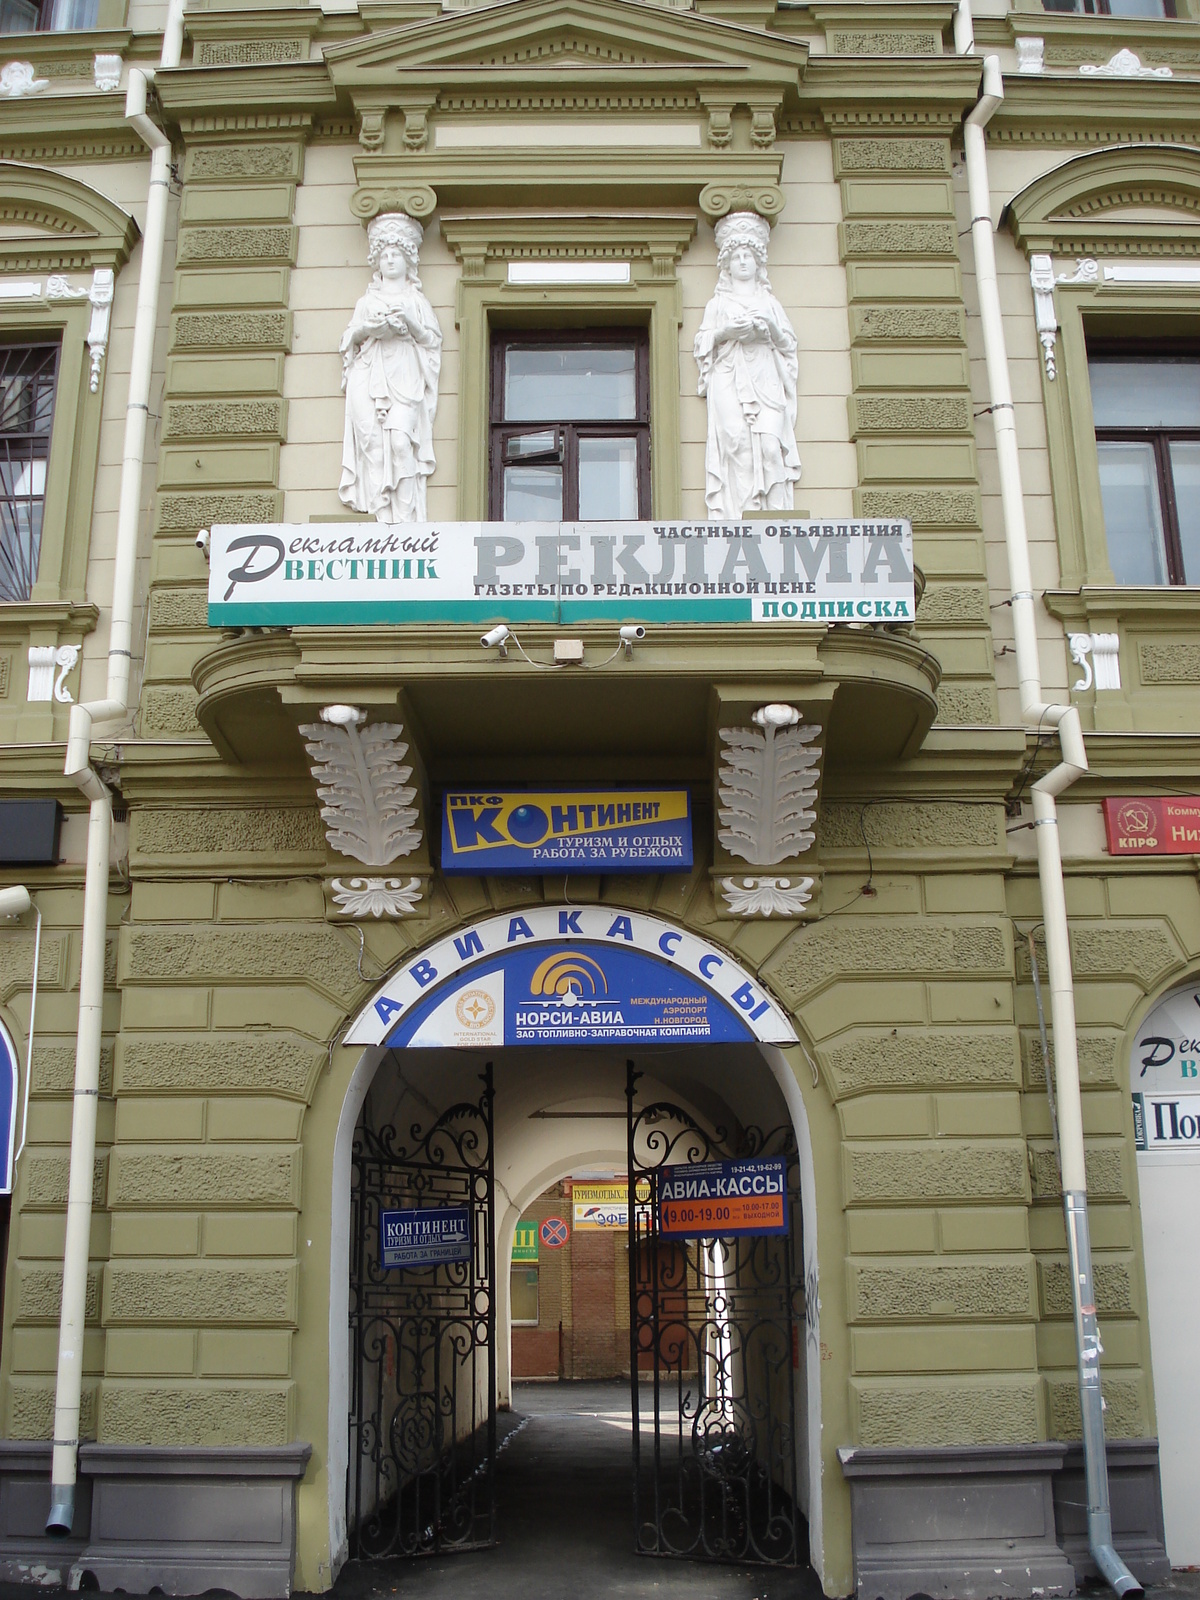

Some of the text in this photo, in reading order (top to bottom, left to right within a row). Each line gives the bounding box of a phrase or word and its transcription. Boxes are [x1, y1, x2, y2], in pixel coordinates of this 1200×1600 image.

[653, 524, 903, 539] ЧАСТНЫЕ ОБЪЯВЛЕНИЯ
[224, 531, 440, 601] Рекламный
[473, 533, 914, 585] РЕКЛАМА
[283, 557, 440, 581] ВЕСТНИК
[474, 578, 816, 597] ГАЗЕТЫ ПО РЕДАКЦИОННОЙ ЦЕНЕ
[762, 600, 909, 619] ПОДПИСКА
[450, 796, 503, 806] ПКФ
[451, 802, 660, 848] КОНТИНЕНТ
[1172, 825, 1200, 842] Ни
[557, 836, 683, 848] ТУРИЗМ И ОТДЫХ
[1119, 837, 1158, 848] КПРФ
[532, 847, 683, 859] РАБОТА ЗА РУБЕЖОМ
[373, 911, 770, 1026] АВИАКАССЫ
[630, 996, 708, 1006] МЕЖДУНАРОДНЫЙ
[663, 1006, 707, 1014] АЭРОПОРТ
[516, 1011, 624, 1026] НОРСИ-АВИА
[654, 1016, 708, 1025] Н.НОВГОРОД
[516, 1028, 711, 1038] ЗАО ТОПЛИВНО-ЗАПРАВОЧНАЯ КОМПАНИЯ
[661, 1174, 783, 1199] АВИА-КАССЫ
[670, 1207, 730, 1222] 9.00-19.00
[743, 1211, 779, 1219] ВЫХОДНОЙ
[387, 1218, 466, 1237] КОНТИНЕНТ
[387, 1233, 442, 1247] ТУРИЗМ И ОТДЫХ
[394, 1252, 418, 1260] РАБОТА
[430, 1248, 462, 1257] ГРАНИЦЕЙ
